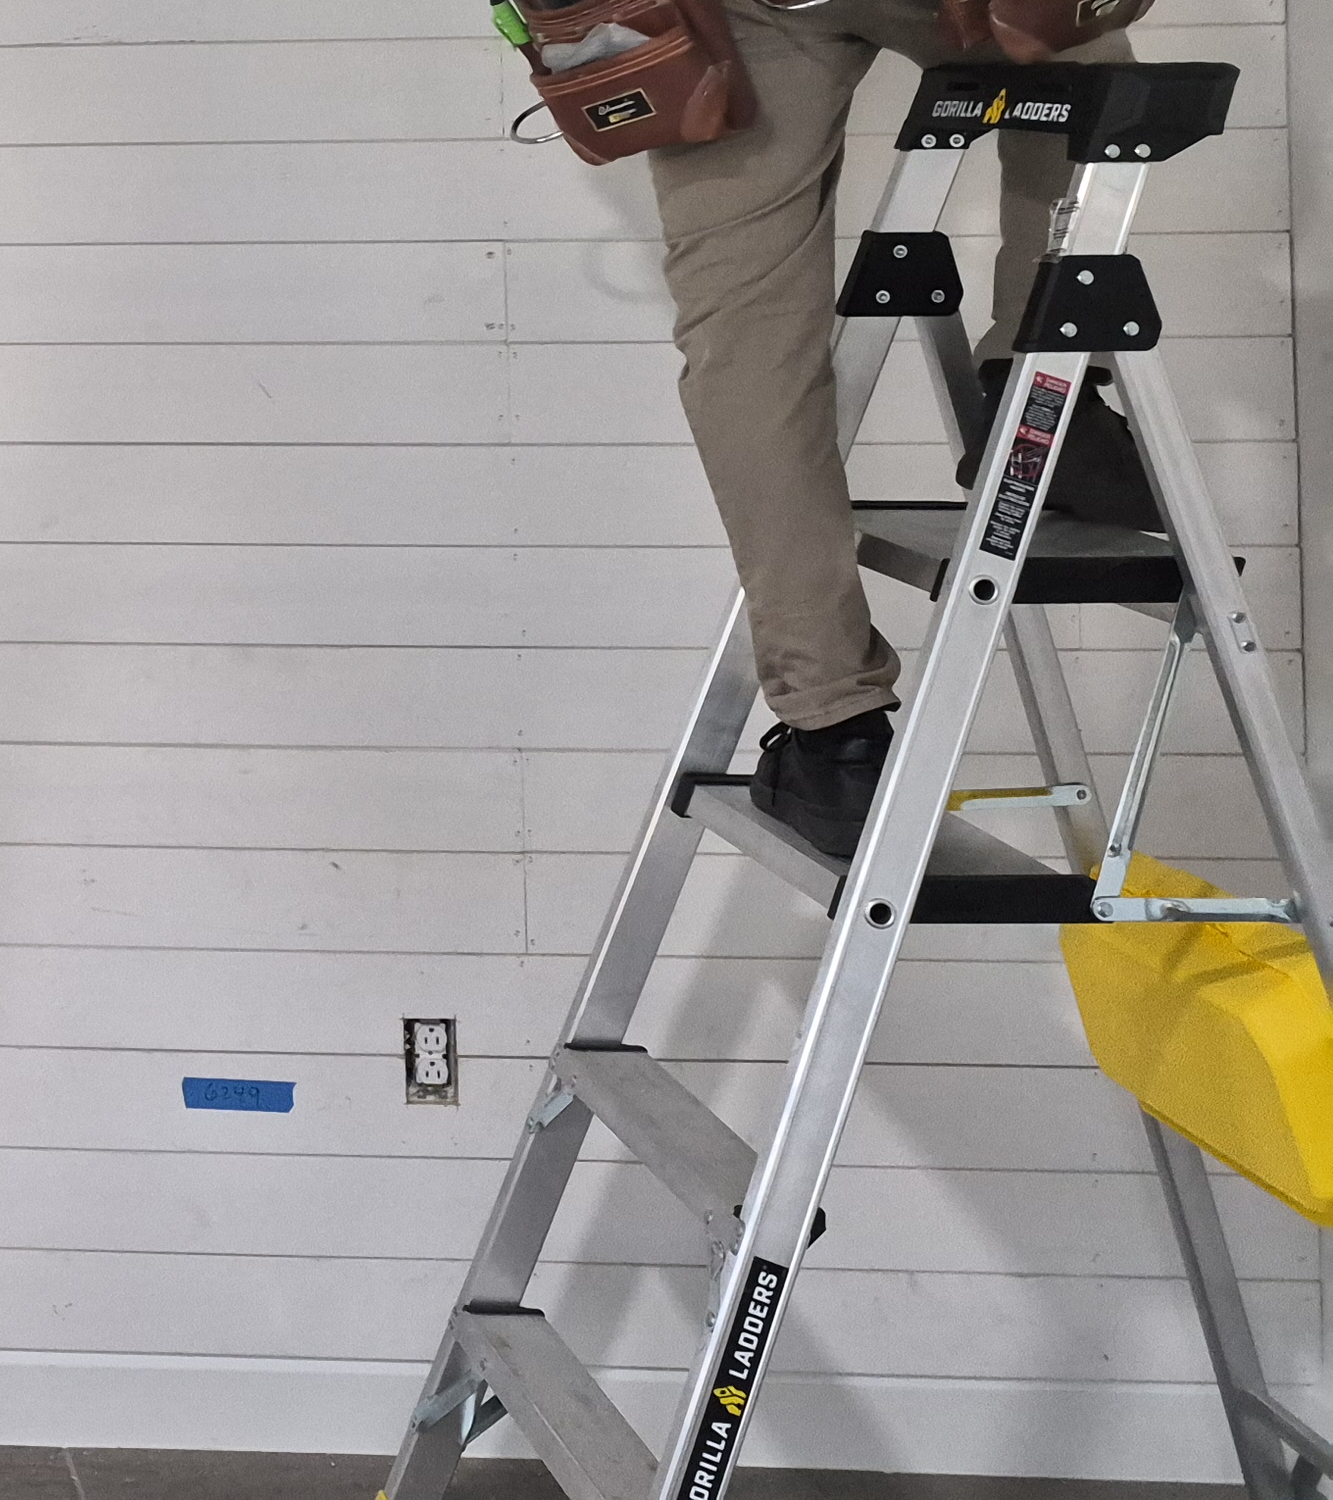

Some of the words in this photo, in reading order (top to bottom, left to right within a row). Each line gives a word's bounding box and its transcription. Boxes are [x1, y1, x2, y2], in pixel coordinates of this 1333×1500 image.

[931, 100, 984, 118] GORILLA
[689, 1421, 732, 1500] ORILLA
[729, 1271, 778, 1380] LADDERS
